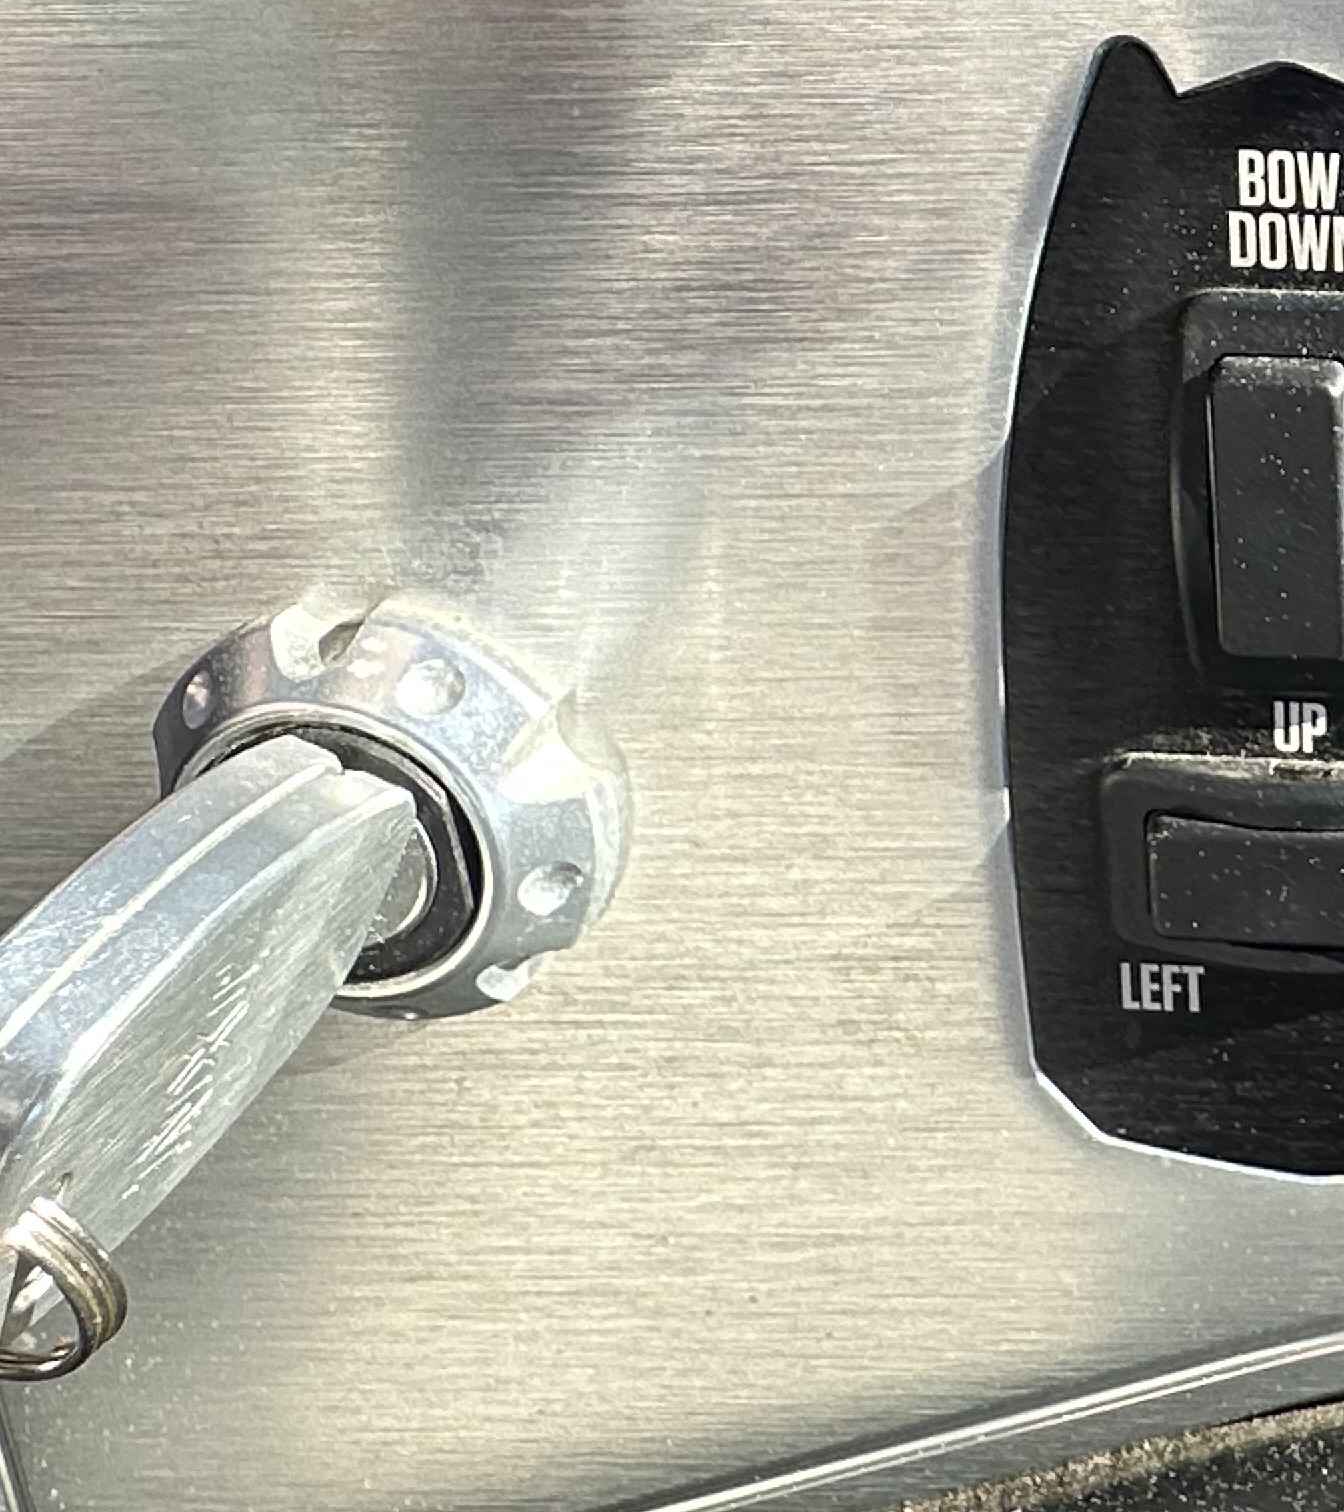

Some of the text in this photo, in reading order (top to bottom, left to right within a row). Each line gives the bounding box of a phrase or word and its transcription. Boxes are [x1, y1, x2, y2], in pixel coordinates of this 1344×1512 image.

[1238, 148, 1341, 210] BOW
[1271, 701, 1329, 754] UP
[1119, 962, 1205, 1014] LEFT
